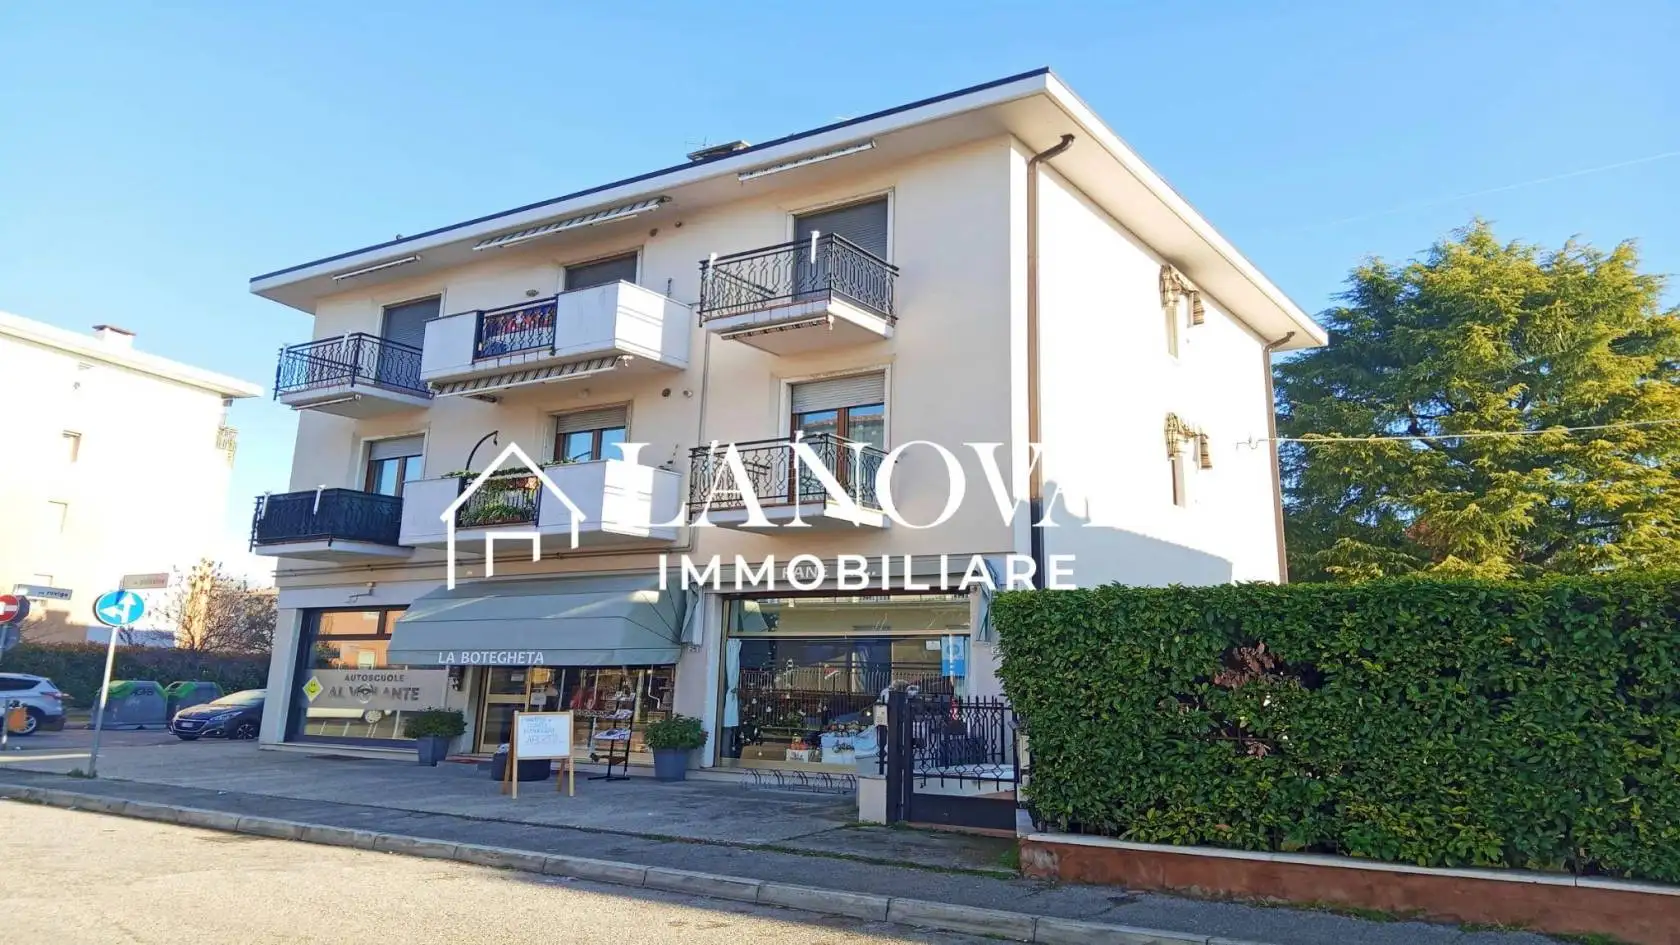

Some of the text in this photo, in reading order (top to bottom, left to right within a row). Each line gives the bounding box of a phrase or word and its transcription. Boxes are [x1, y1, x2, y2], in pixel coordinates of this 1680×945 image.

[438, 651, 544, 664] LA BOTEGHETA
[344, 674, 405, 682] AUTOSCUOLE
[328, 686, 344, 697] AL
